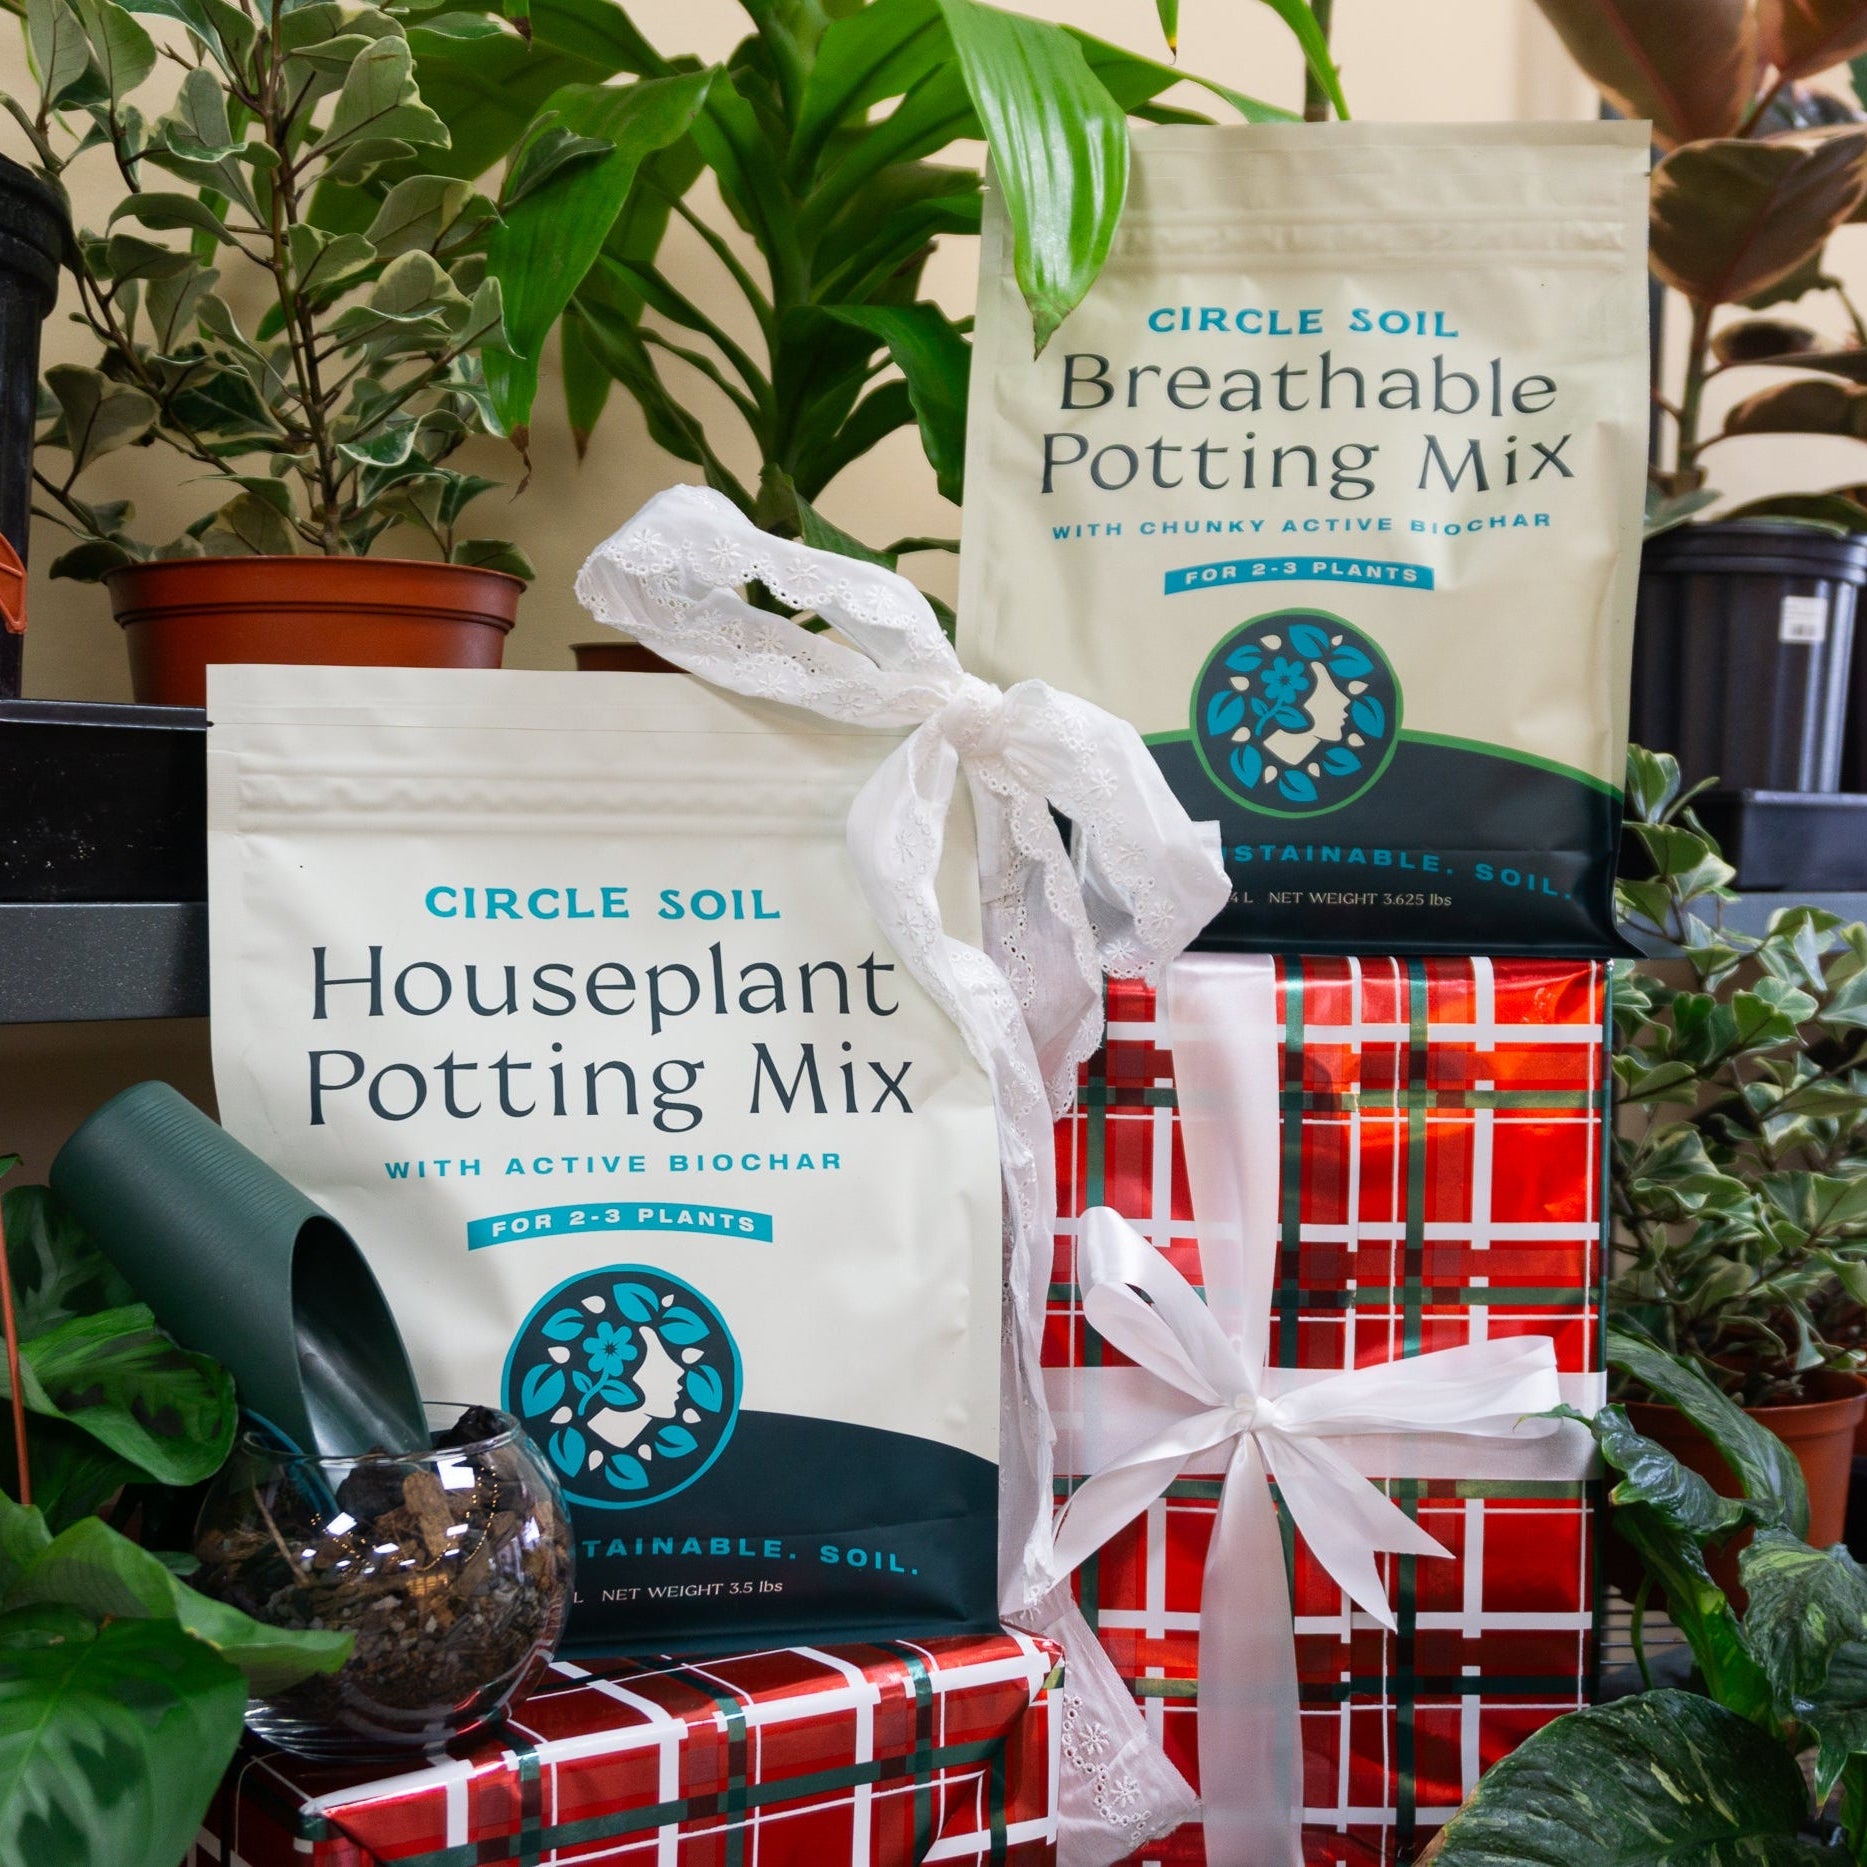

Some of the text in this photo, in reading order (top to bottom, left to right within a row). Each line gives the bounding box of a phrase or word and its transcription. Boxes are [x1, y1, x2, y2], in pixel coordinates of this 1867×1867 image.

[1148, 306, 1459, 337] CIRCLE SOIL
[1060, 350, 1558, 417] Breathable
[1040, 432, 1575, 500] Potting Mix
[1052, 513, 1551, 540] WITH CHUNKY ACTIVE BIOCHAR
[1185, 562, 1417, 585] FOR 2-3 PLANTS
[1221, 845, 1572, 900] STAINABLE. SOIL.
[425, 886, 781, 919] CIRCLE SOIL
[1244, 892, 1254, 903] L
[1268, 892, 1303, 904] NET
[1309, 892, 1378, 905] WEIGHT
[1384, 893, 1425, 906] 3.625
[1430, 893, 1452, 907] lbs
[312, 941, 899, 1035] Houseplant
[307, 1041, 914, 1133] Potting Mix
[385, 1153, 841, 1179] WITH ACTIVE BIOCHAR
[492, 1209, 755, 1237] FOR 2-3 PLANTS
[582, 1537, 918, 1575] TAINABLE. SOIL.
[573, 1580, 783, 1603] L NET WEIGHT 3.5 lbs
